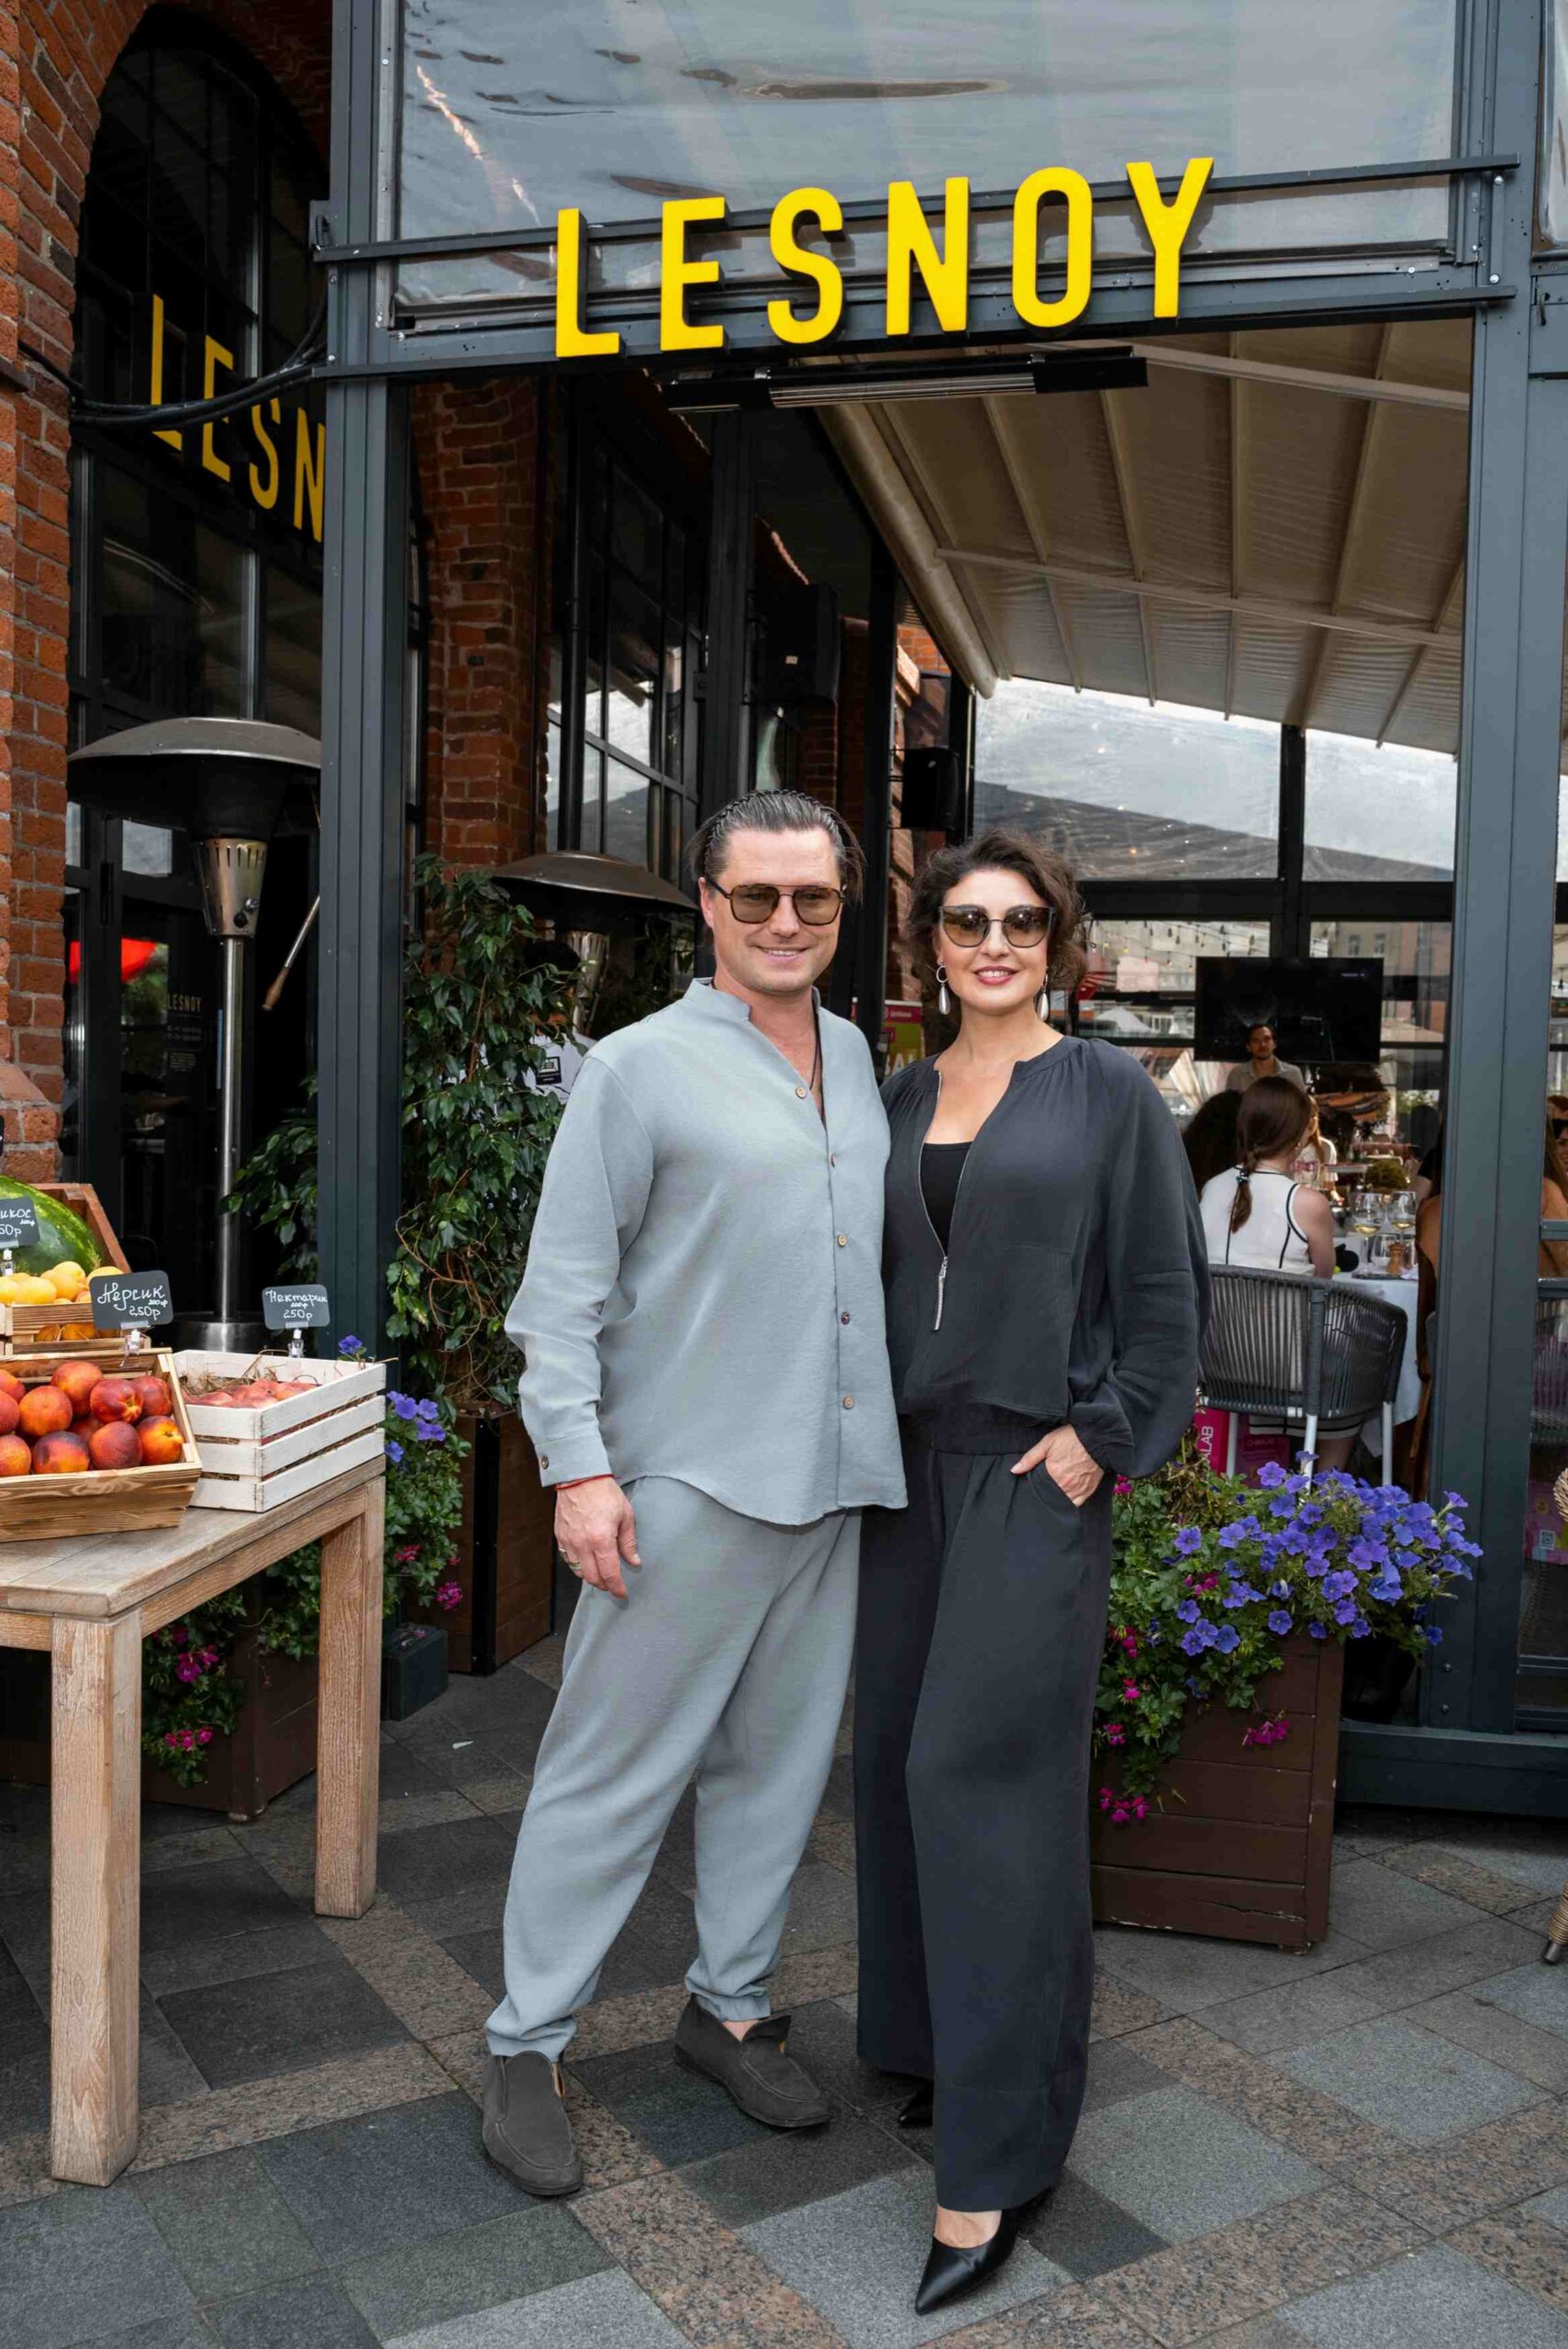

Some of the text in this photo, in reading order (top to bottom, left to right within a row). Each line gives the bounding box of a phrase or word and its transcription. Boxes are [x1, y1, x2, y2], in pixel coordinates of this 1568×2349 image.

[554, 157, 1215, 358] LESNOY
[167, 992, 202, 1013] LESNOY
[97, 1282, 165, 1311] Персик
